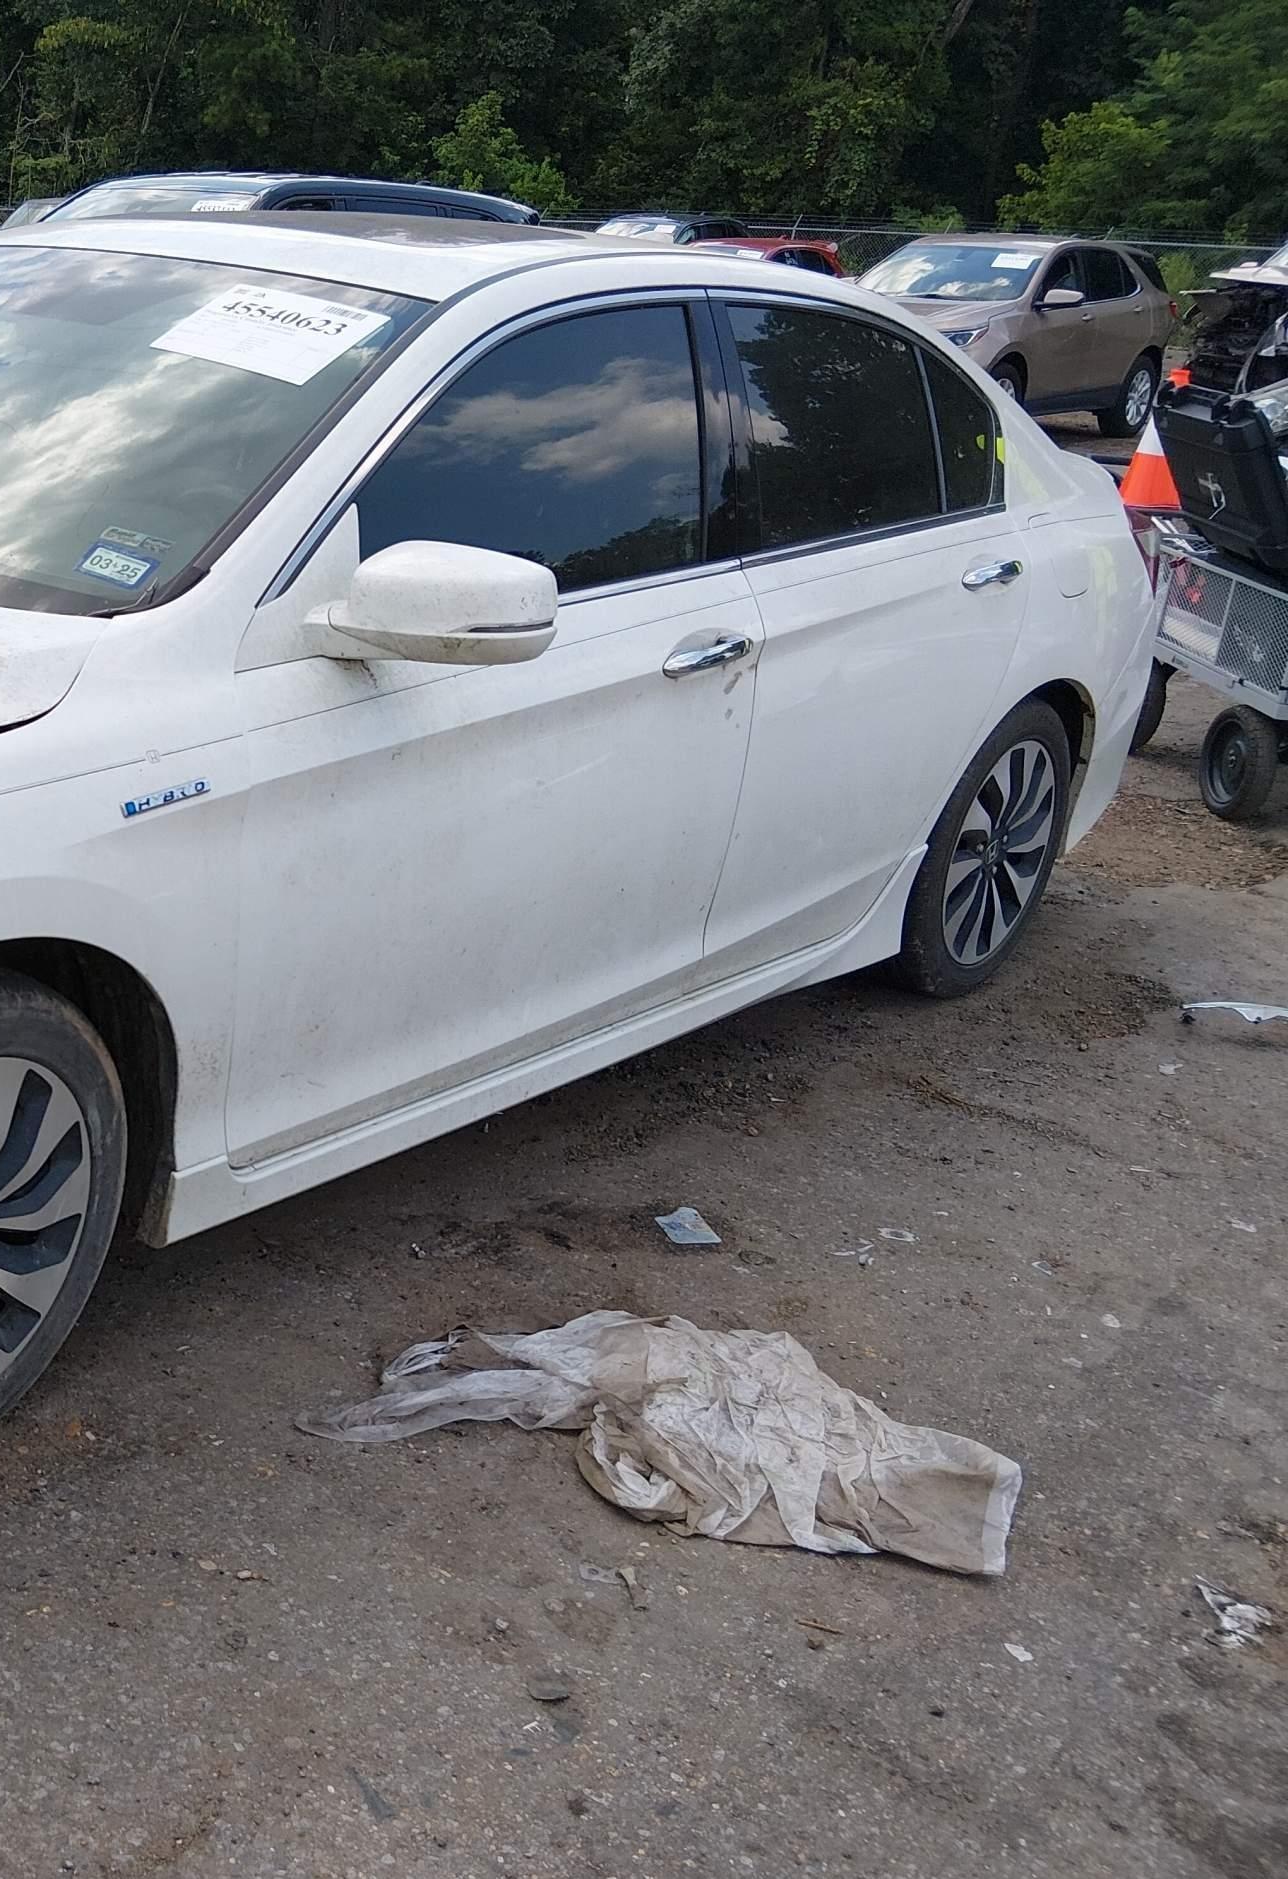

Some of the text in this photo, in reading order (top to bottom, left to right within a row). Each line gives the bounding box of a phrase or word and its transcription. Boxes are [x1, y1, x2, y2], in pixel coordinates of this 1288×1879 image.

[222, 301, 348, 336] 45540623
[89, 554, 142, 579] 03 25
